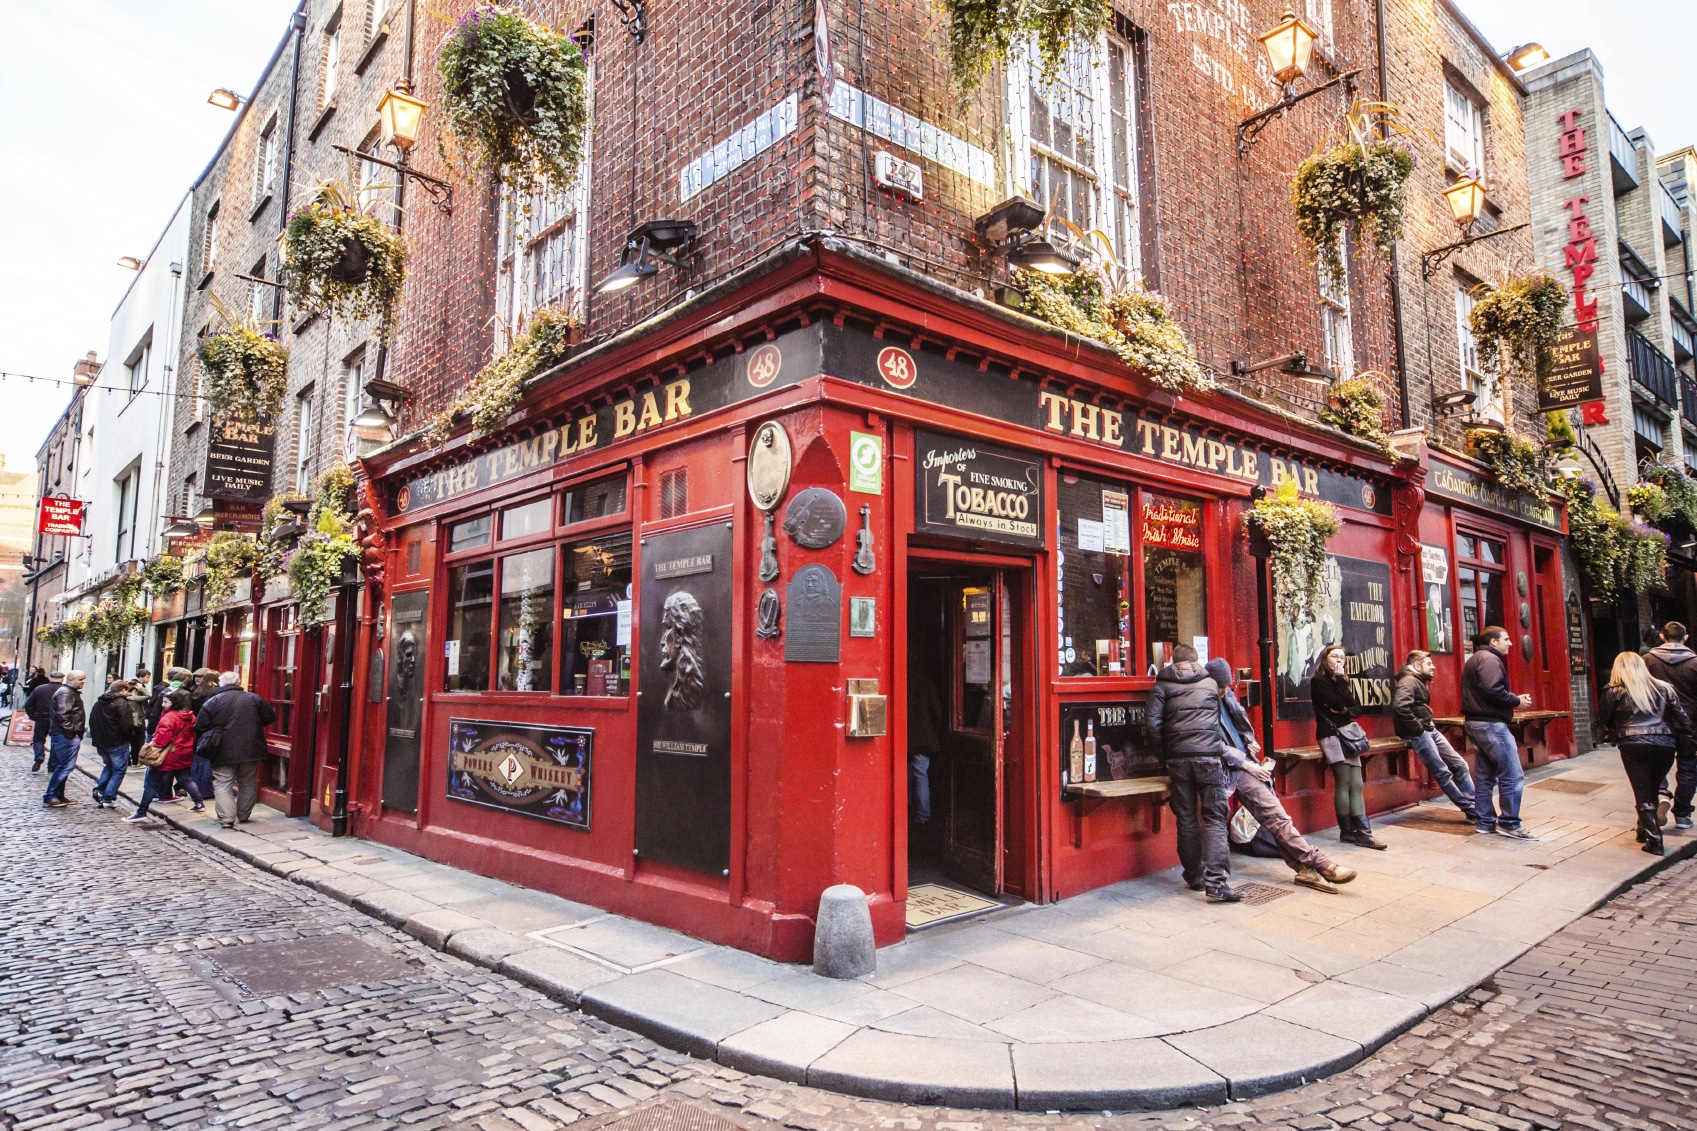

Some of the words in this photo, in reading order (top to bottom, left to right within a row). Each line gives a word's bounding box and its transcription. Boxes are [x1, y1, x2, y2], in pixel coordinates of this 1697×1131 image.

[1167, 2, 1249, 61] TEMPLE
[866, 116, 905, 141] TEMPLE
[908, 135, 937, 156] LANE
[1557, 107, 1587, 180] THE
[714, 147, 745, 177] TEMPLE
[747, 134, 768, 155] BAR
[1562, 194, 1600, 333] TEMPLE
[752, 352, 775, 380] 48
[884, 352, 909, 381] 48
[1563, 368, 1593, 380] GARDEN
[1559, 393, 1581, 402] DAILY
[1566, 385, 1591, 395] MUSIC
[223, 429, 260, 444] BAR
[433, 459, 479, 500] THE
[486, 414, 598, 481] TEMPLE
[612, 378, 693, 440] BAR
[1041, 391, 1125, 447] THE
[1136, 418, 1260, 481] TEMPLE
[1270, 457, 1320, 496] BAR
[210, 452, 234, 461] BEER
[235, 455, 270, 466] GARDEN
[922, 447, 977, 472] Importers
[956, 463, 967, 473] OF
[212, 474, 234, 483] LIVE
[235, 477, 264, 487] MUSIC
[225, 482, 252, 491] DAILY
[970, 471, 990, 486] FINE
[990, 475, 1028, 492] SMOKING
[54, 500, 71, 508] THE
[937, 472, 1029, 520] TOBACCO
[1363, 489, 1373, 504] 48
[45, 506, 80, 515] TEMPLE
[51, 513, 71, 521] BAR
[215, 511, 262, 521] MERCHANDISE
[229, 504, 246, 512] BAR
[1142, 503, 1197, 525] Traditional
[957, 513, 993, 528] Always
[997, 519, 1006, 530] in
[1009, 520, 1035, 535] Stock
[1142, 522, 1167, 543] Irish
[1170, 527, 1200, 548] Music
[655, 562, 667, 573] THE
[669, 556, 696, 571] TEMPLE
[696, 554, 712, 566] BAR
[1367, 581, 1384, 602] THE
[1349, 601, 1385, 624] EMPEROR
[1375, 626, 1385, 645] OF
[1361, 646, 1389, 675] LIQUORS
[1097, 707, 1126, 727] THE
[685, 743, 708, 753] TEMPLE
[463, 755, 493, 772] POWERS
[507, 757, 517, 781] P
[530, 764, 572, 785] WHISKEY
